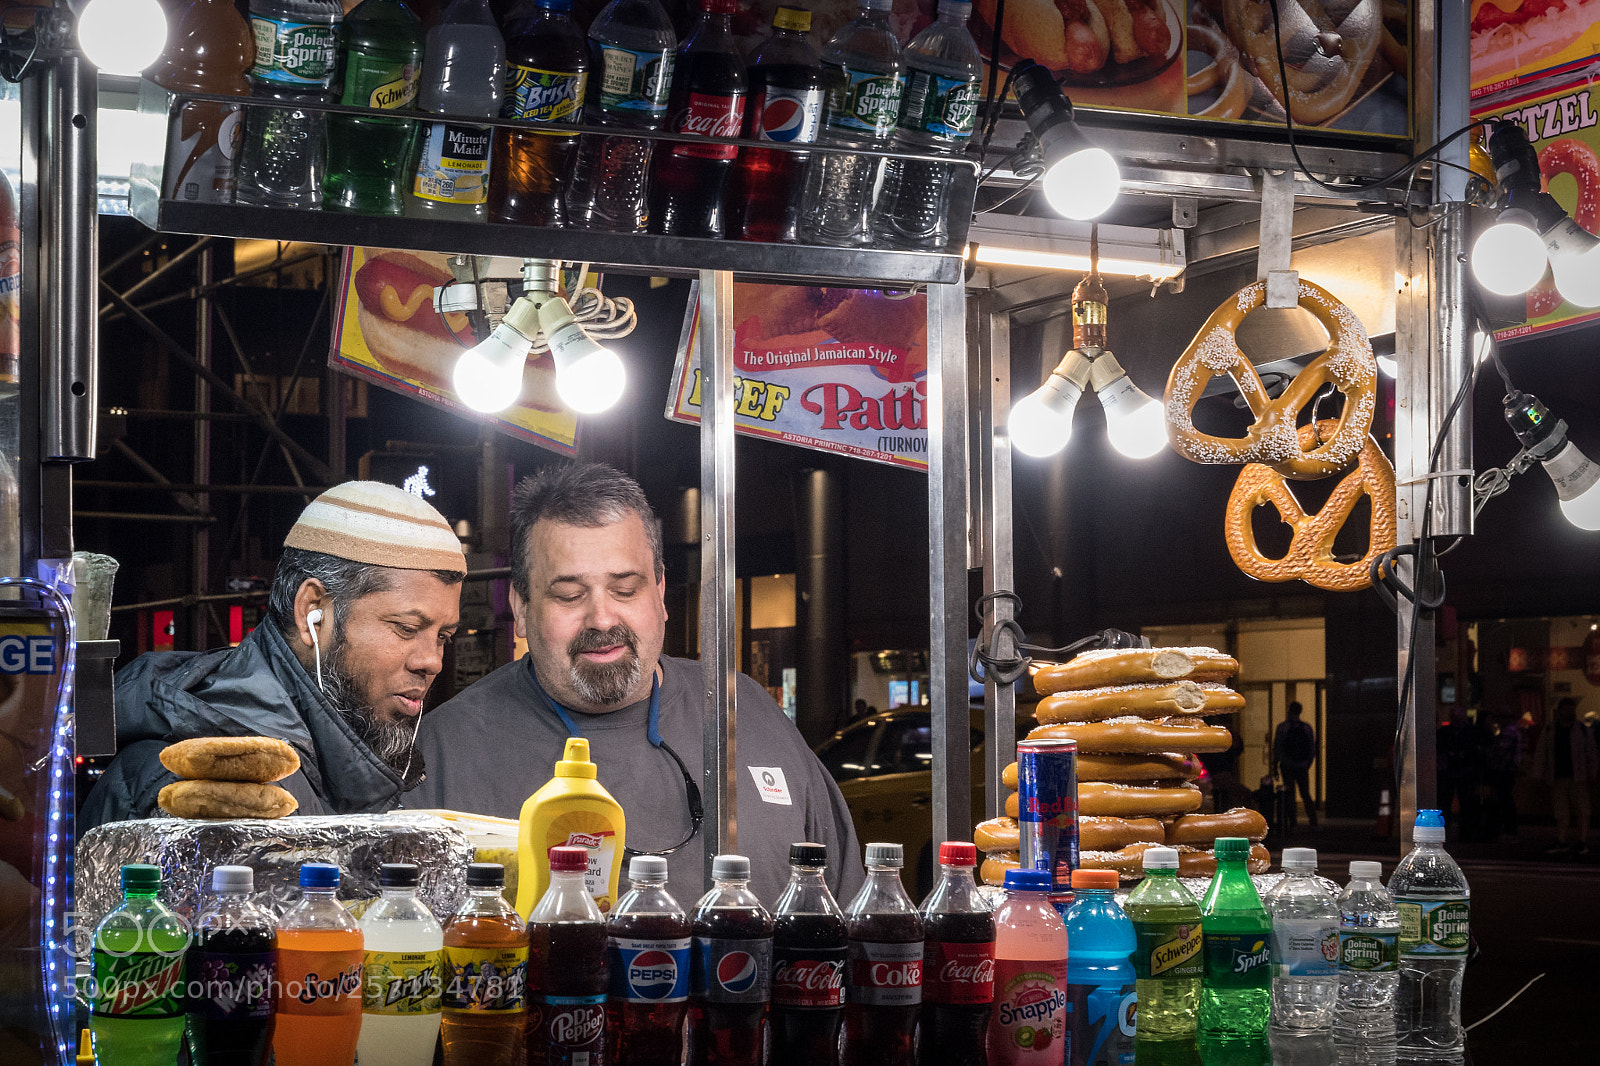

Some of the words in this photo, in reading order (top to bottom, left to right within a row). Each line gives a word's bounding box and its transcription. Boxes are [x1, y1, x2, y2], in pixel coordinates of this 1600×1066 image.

[525, 76, 577, 110] Brisk
[523, 109, 539, 119] ICED
[540, 105, 553, 114] TEA
[857, 95, 900, 119] Spring
[448, 130, 488, 145] Minute
[453, 143, 482, 155] Maid
[743, 351, 764, 366] The
[766, 347, 812, 367] Original
[814, 346, 867, 362] Jamaican
[868, 346, 898, 364] Style
[782, 432, 813, 446] ASTORIA
[814, 438, 848, 453] PRINTING
[848, 446, 893, 461] 718-267-1201
[1028, 796, 1062, 814] Red
[1064, 796, 1079, 813] Bu
[1437, 909, 1469, 923] Poland
[1155, 932, 1202, 969] Schweppe
[1347, 939, 1377, 949] Poland
[1234, 947, 1270, 974] Sprite
[1344, 948, 1380, 964] Spring
[630, 968, 676, 981] PEPSI
[775, 959, 846, 990] Coca-Cola
[870, 963, 921, 986] Coke
[940, 959, 995, 984] Coca-Cola
[1174, 966, 1198, 974] GINGER
[573, 1008, 594, 1026] Dr
[1000, 990, 1065, 1025] Snapple
[551, 1012, 603, 1042] Pepper
